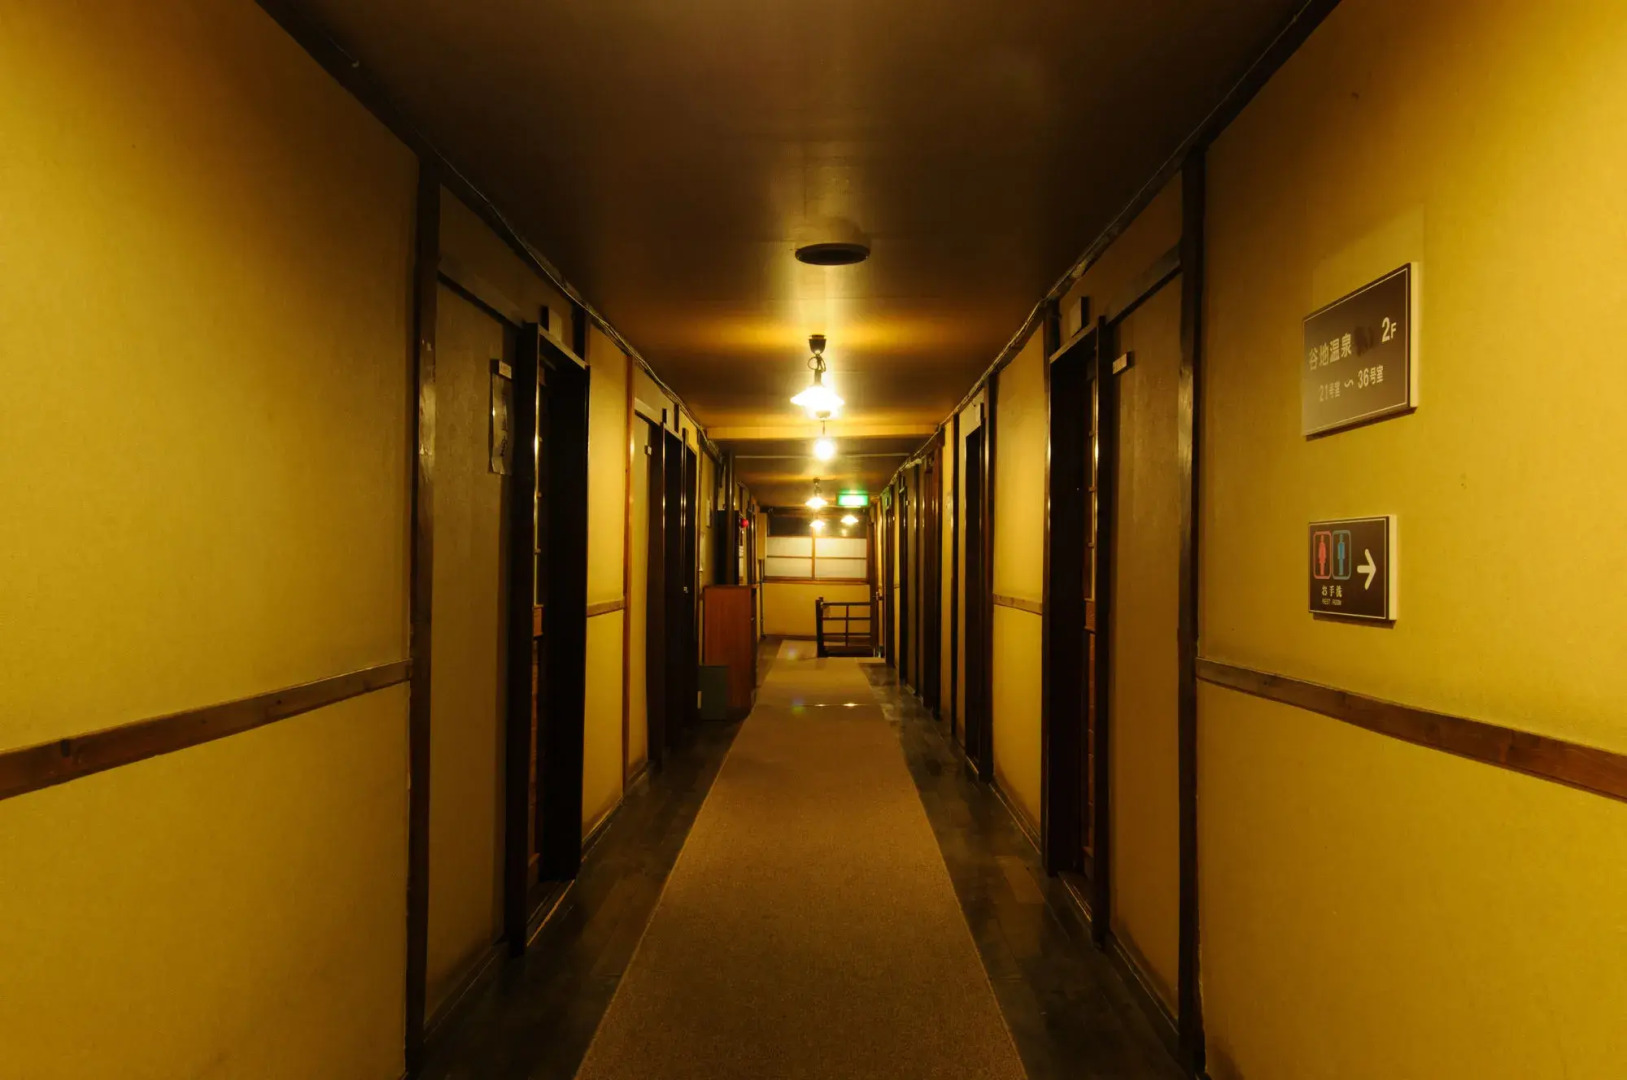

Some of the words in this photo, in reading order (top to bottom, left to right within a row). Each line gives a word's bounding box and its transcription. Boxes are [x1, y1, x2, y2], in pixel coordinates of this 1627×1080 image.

[1381, 316, 1397, 343] 2F
[1309, 333, 1352, 370] 谷地温泉
[1319, 381, 1341, 402] 21号室
[1357, 364, 1384, 389] 36号室
